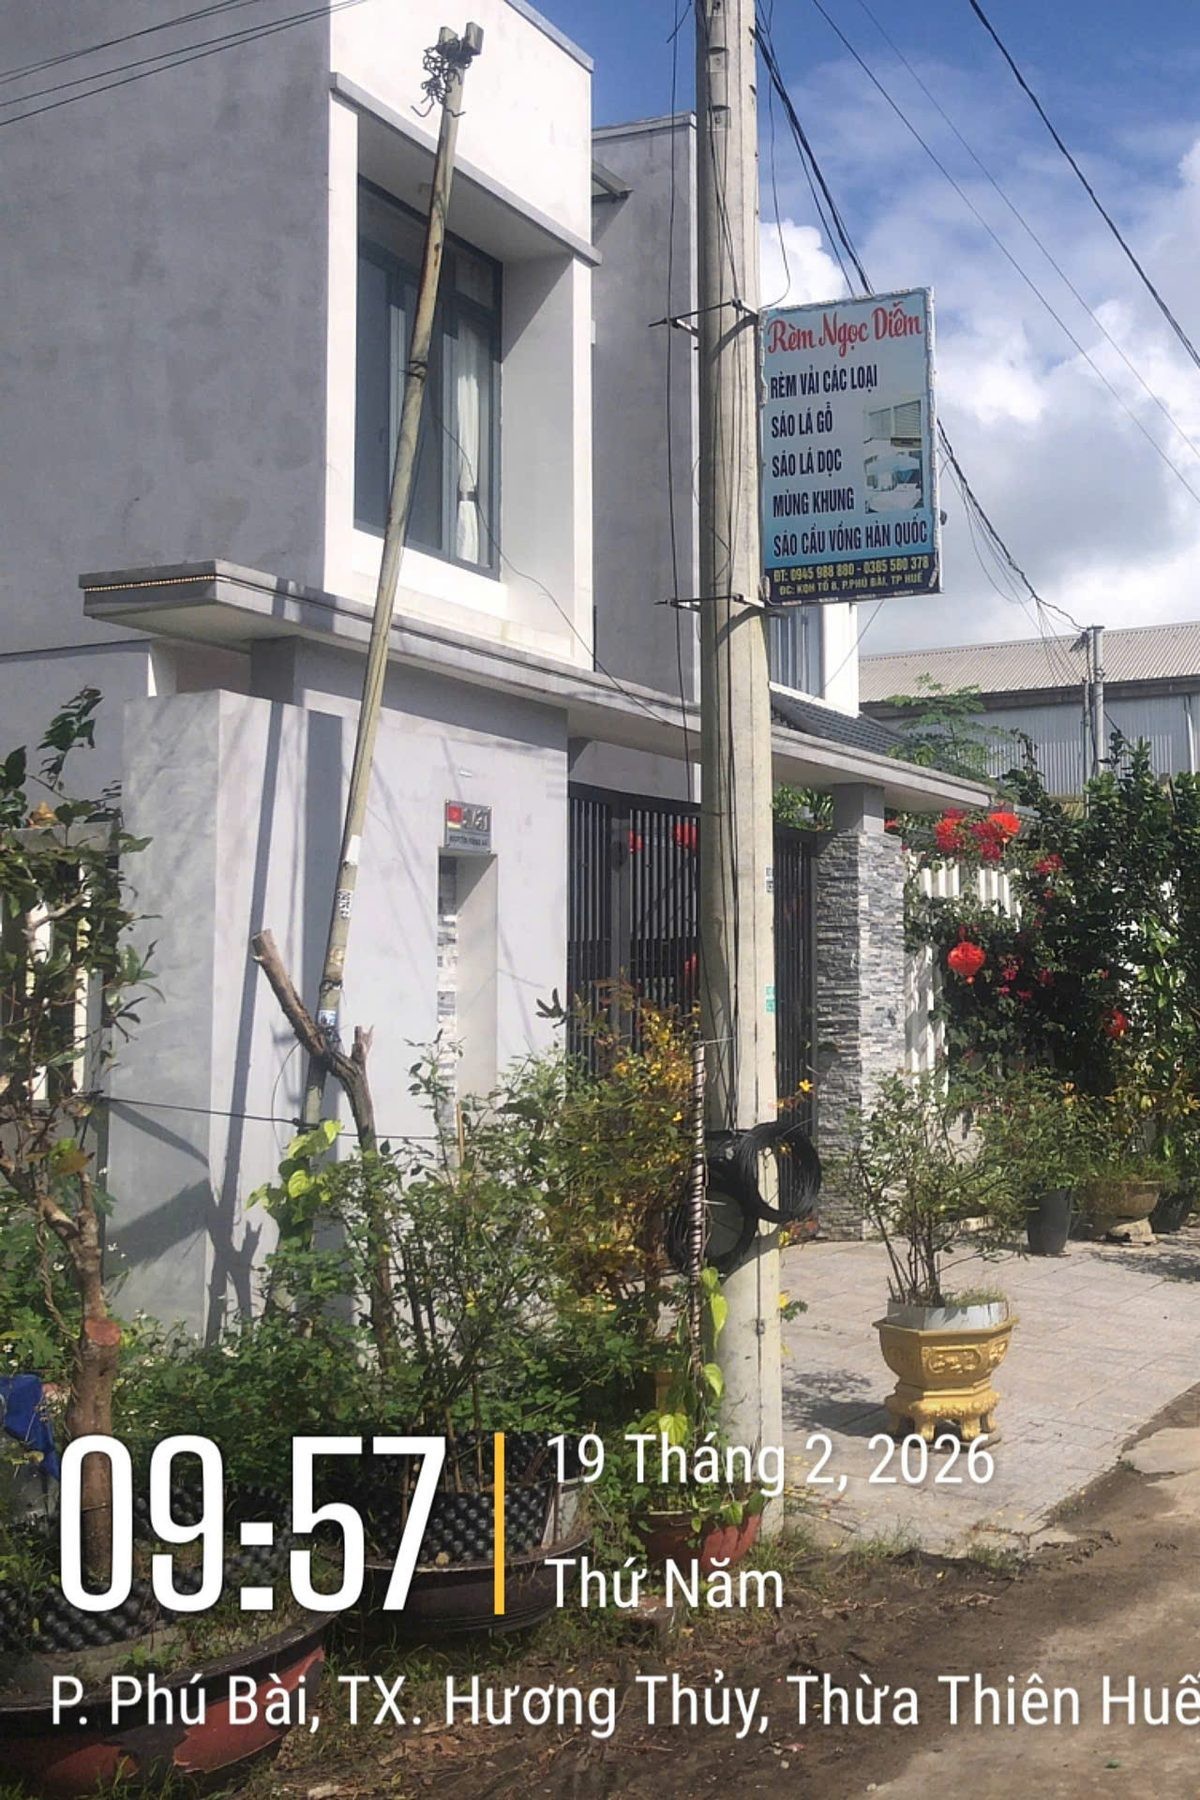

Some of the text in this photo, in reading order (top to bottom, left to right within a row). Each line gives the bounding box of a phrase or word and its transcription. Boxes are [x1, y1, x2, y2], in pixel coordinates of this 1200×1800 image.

[768, 302, 922, 358] Rèm Ngọc Diễm
[770, 364, 877, 399] RÈM VẢI CÁC LOẠI
[771, 401, 833, 438] SÁO LÁ GỖ
[772, 446, 842, 478] SÁO LÁ DỌC
[773, 486, 854, 518] MÙNG KHUNG
[773, 529, 797, 558] SÁO
[865, 520, 890, 549] HÀN
[895, 513, 928, 548] QUỐC
